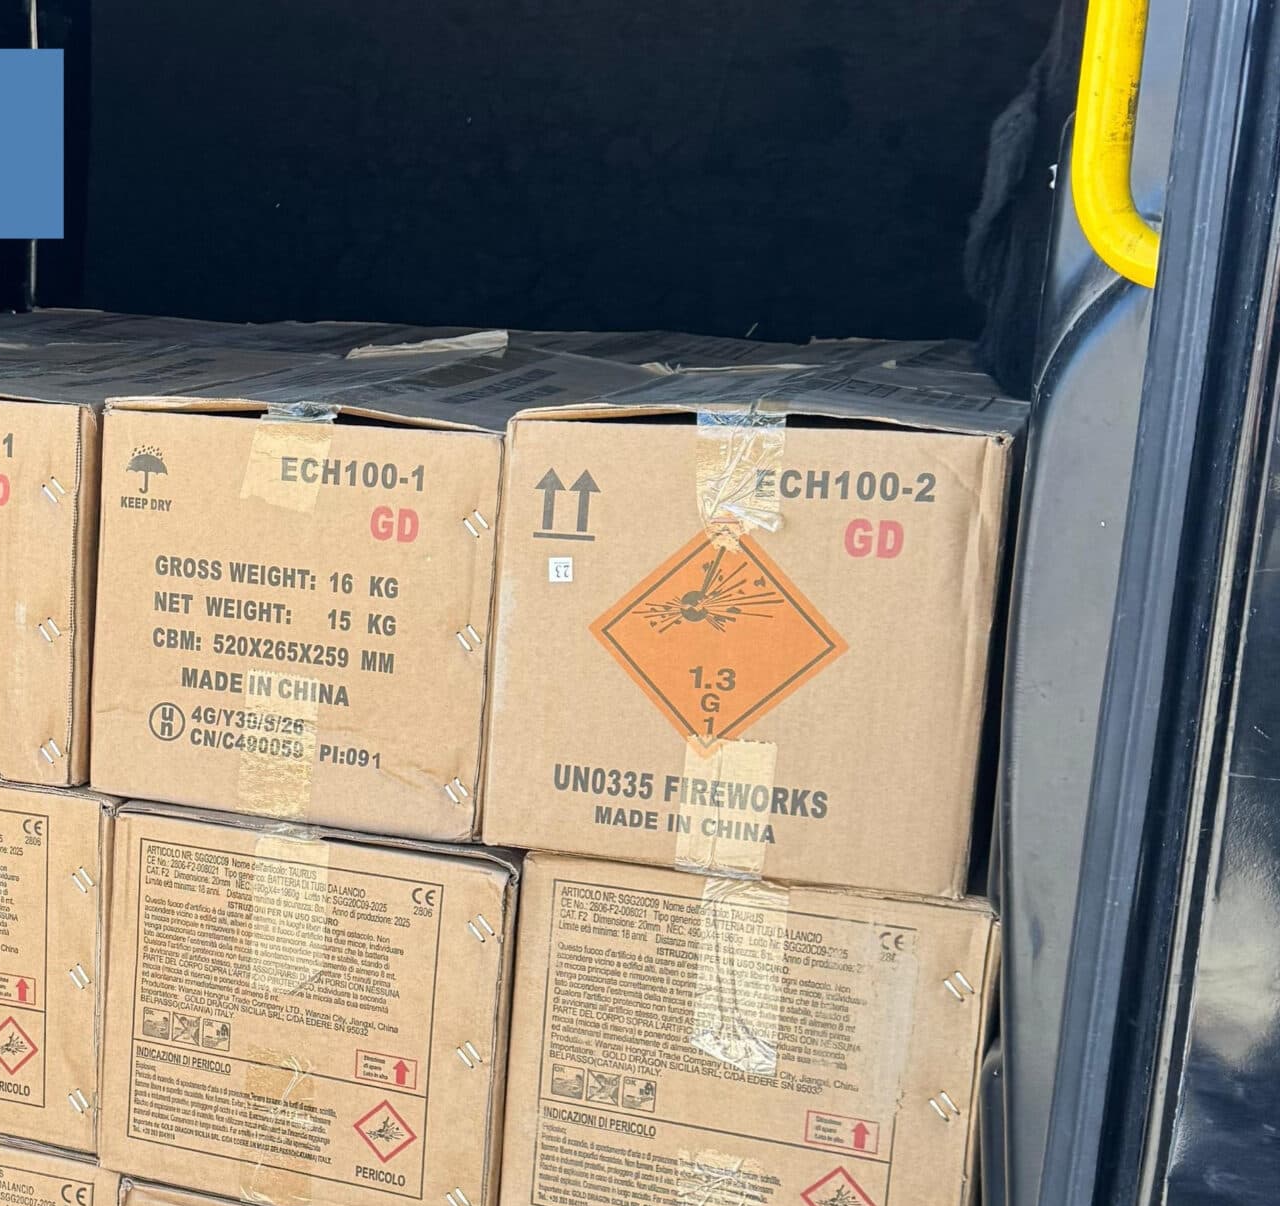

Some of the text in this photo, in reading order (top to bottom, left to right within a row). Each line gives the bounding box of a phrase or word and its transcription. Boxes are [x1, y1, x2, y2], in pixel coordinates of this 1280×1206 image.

[281, 457, 424, 491] ECH100-1
[755, 468, 936, 502] ECH100-2
[121, 497, 172, 511] KEEP DRY
[371, 507, 419, 543] GD
[844, 519, 904, 558] GD
[155, 555, 398, 598] GROSS WEIGHT: 16 KG
[154, 593, 396, 636] NET WEIGHT: 15 KG
[153, 628, 394, 674] CBM: 520X265X259 MM
[182, 668, 349, 706] MADE IN CHINA
[689, 666, 736, 690] 1.3
[701, 694, 719, 712] G
[704, 717, 714, 734] 1
[320, 745, 380, 769] PI:091
[554, 764, 827, 818] UN0335 FIREWORKS
[595, 806, 775, 843] MADE IN CHINA
[185, 995, 239, 1010] GOLD DRAGON
[136, 1046, 231, 1074] INDICAZIONI DI PERICOLO
[544, 1106, 656, 1136] INDICAZIONI DI PERICOLO
[8, 1182, 34, 1195] LANCIO
[355, 1166, 405, 1187] PERICOLO
